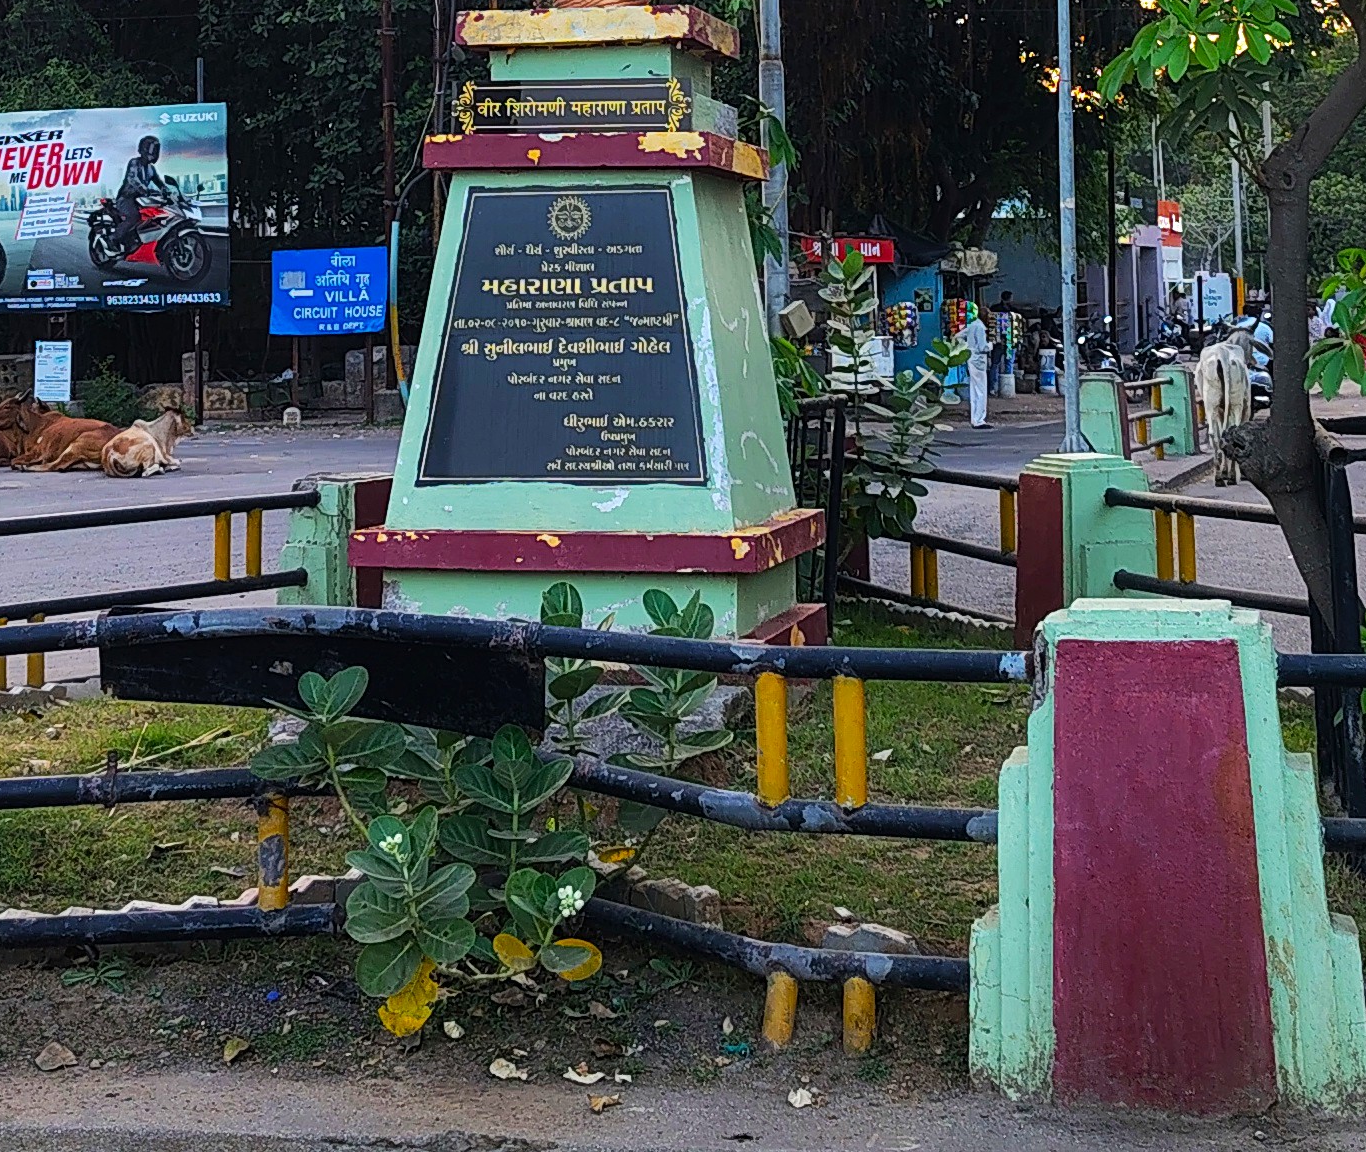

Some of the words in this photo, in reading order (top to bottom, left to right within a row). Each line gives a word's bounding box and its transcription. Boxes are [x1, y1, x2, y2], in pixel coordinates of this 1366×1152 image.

[476, 97, 501, 117] वीर
[505, 96, 566, 118] शिरोमणी
[570, 100, 627, 116] महाराणा
[631, 100, 666, 115] प्रताप
[172, 112, 218, 123] SUZUKI
[65, 147, 93, 161] LETS
[9, 171, 28, 184] ME
[27, 160, 104, 190] DOWN
[606, 244, 643, 255] અડગતા
[860, 242, 881, 257] પાન
[541, 260, 561, 272] પ્રેરક
[481, 277, 582, 295] મહારાણા
[589, 276, 654, 294] પ્રતાપ
[324, 289, 370, 303] VILLA
[505, 297, 533, 309] પ્રતિમા
[535, 300, 576, 309] અનાવરણ
[578, 297, 598, 309] વિધિ
[293, 306, 339, 319] CIRCUIT
[344, 305, 384, 318] HOUSE
[460, 338, 479, 355] શ્રી
[483, 338, 554, 361] સુનીલભાઈ
[558, 337, 625, 355] દેવશીભાઈ
[629, 336, 671, 354] ગોહેલ
[552, 358, 577, 371] પ્રમુખ
[507, 372, 545, 385] પોરબંદર
[547, 374, 572, 385] નગર
[574, 371, 594, 385] સેવા
[597, 373, 621, 384] સદન
[533, 390, 546, 401] ના
[549, 390, 569, 401] વરદ
[563, 413, 609, 432] ધીરુભાઈ
[565, 445, 600, 457] પોરબંદર
[603, 446, 625, 457] નગર
[628, 445, 646, 457] સેવા
[649, 446, 671, 457] સદન
